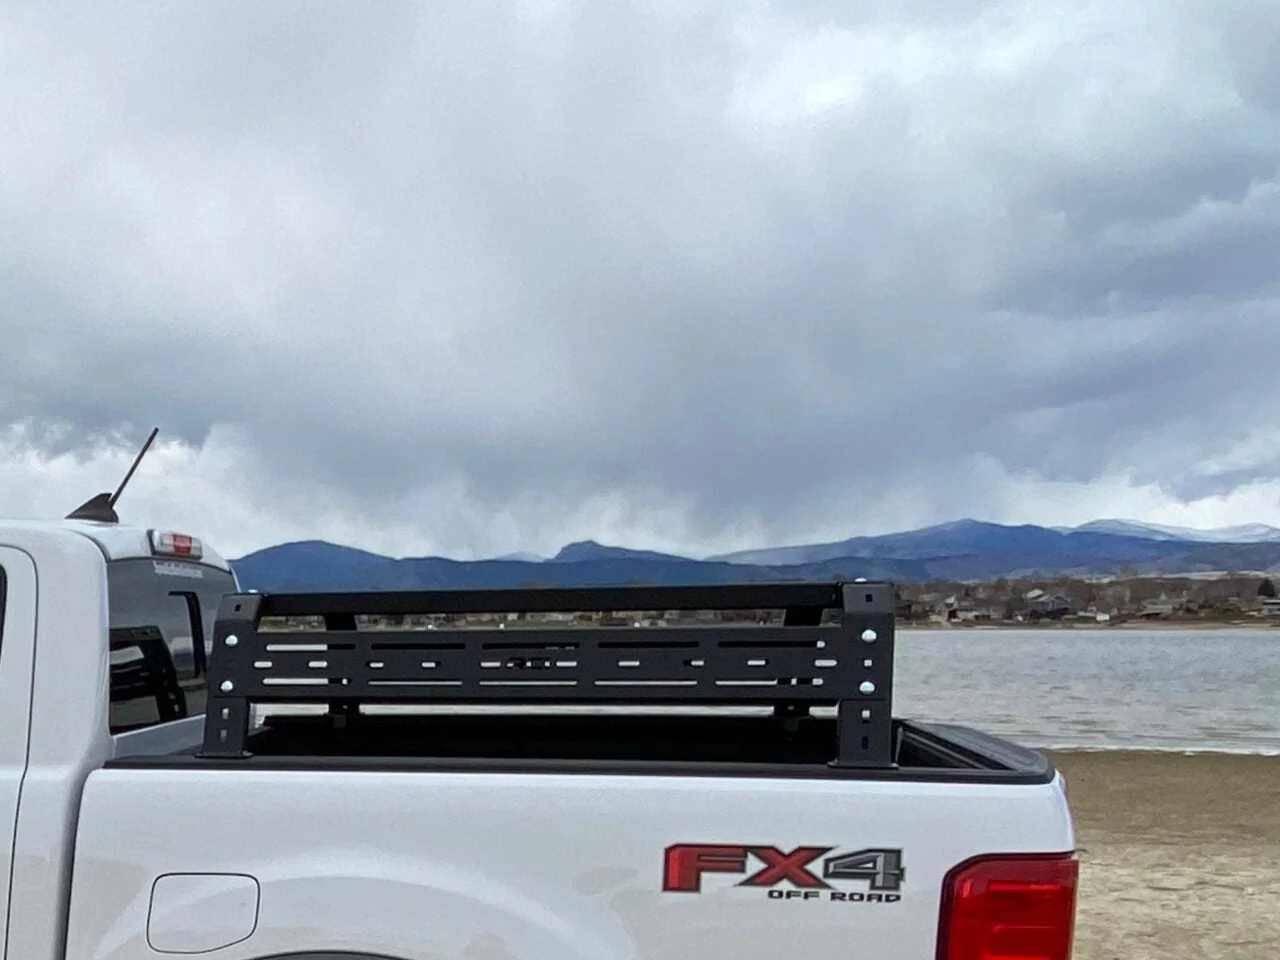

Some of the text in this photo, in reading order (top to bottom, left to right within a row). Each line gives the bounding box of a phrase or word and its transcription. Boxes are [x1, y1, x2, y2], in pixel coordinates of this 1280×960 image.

[662, 843, 905, 893] FX4
[767, 889, 902, 903] OFF ROAD
